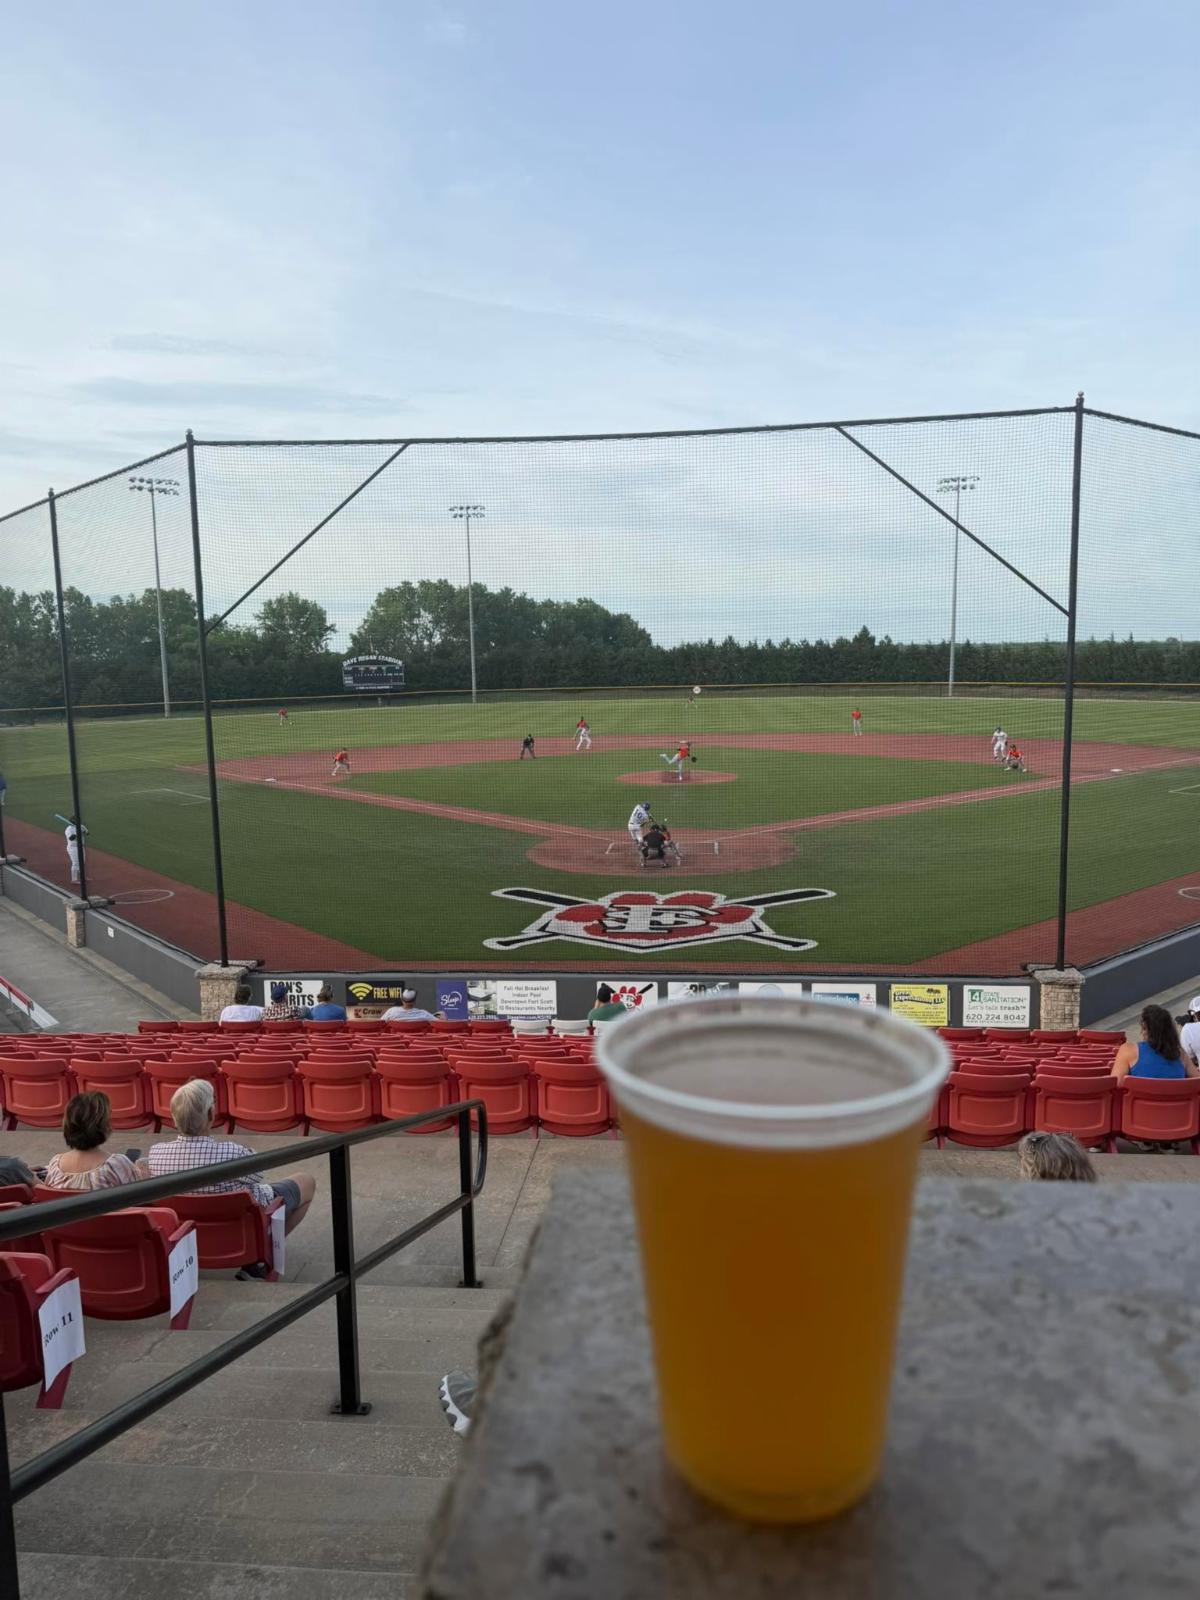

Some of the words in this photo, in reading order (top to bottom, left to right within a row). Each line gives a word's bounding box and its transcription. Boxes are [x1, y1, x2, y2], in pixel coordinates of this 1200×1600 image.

[342, 657, 358, 667] DAVE
[373, 987, 388, 999] FREE
[172, 1268, 184, 1285] Row
[185, 1255, 194, 1268] 10
[44, 1326, 59, 1347] Row
[61, 1311, 74, 1327] 11
